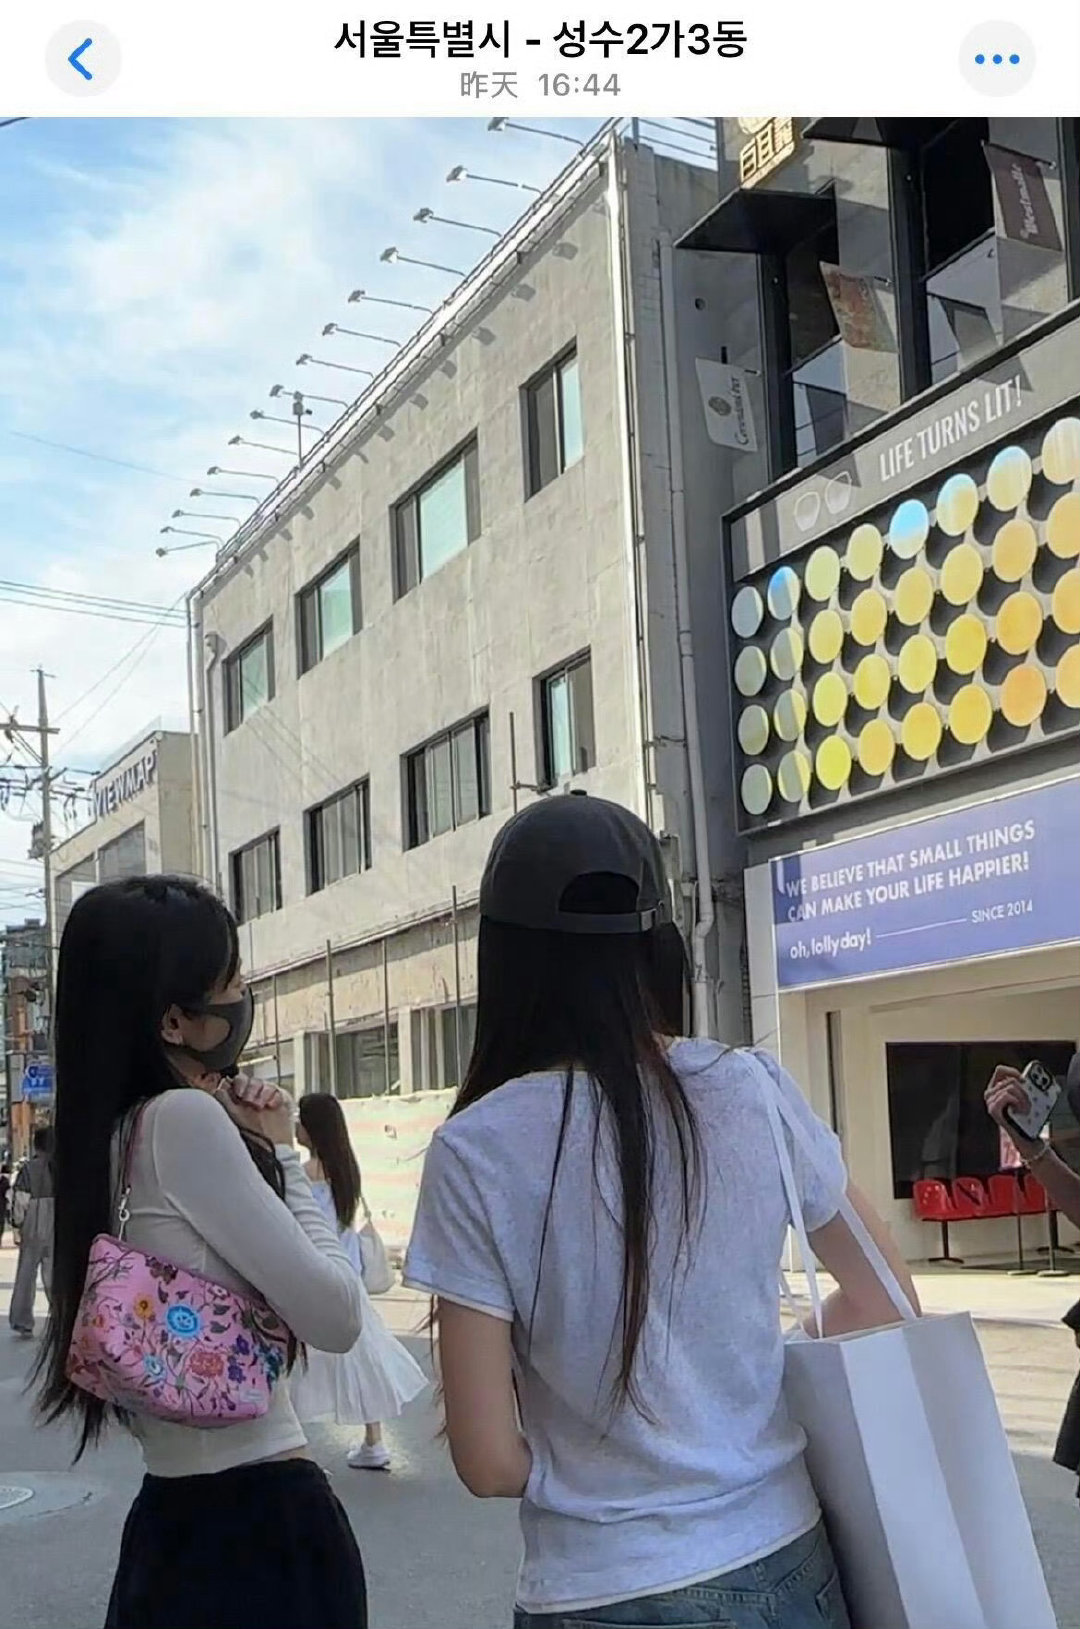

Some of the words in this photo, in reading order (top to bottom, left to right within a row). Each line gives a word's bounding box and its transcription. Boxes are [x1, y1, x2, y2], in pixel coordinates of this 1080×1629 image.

[879, 437, 915, 482] LIFE
[916, 400, 981, 460] TURNS
[984, 374, 1022, 424] LIT!
[785, 877, 808, 898] WE
[811, 864, 863, 892] BELIEVE
[866, 853, 904, 879] THAT
[910, 839, 963, 869] SMALL
[966, 819, 1036, 854] THINGS
[787, 901, 818, 922] CAN
[821, 890, 862, 915] MAKE
[866, 880, 910, 905] YOUR
[913, 871, 945, 896] LIFE
[948, 850, 1030, 888] HAPPIER!
[971, 904, 1005, 924] SINCE
[1007, 899, 1034, 917] 2014
